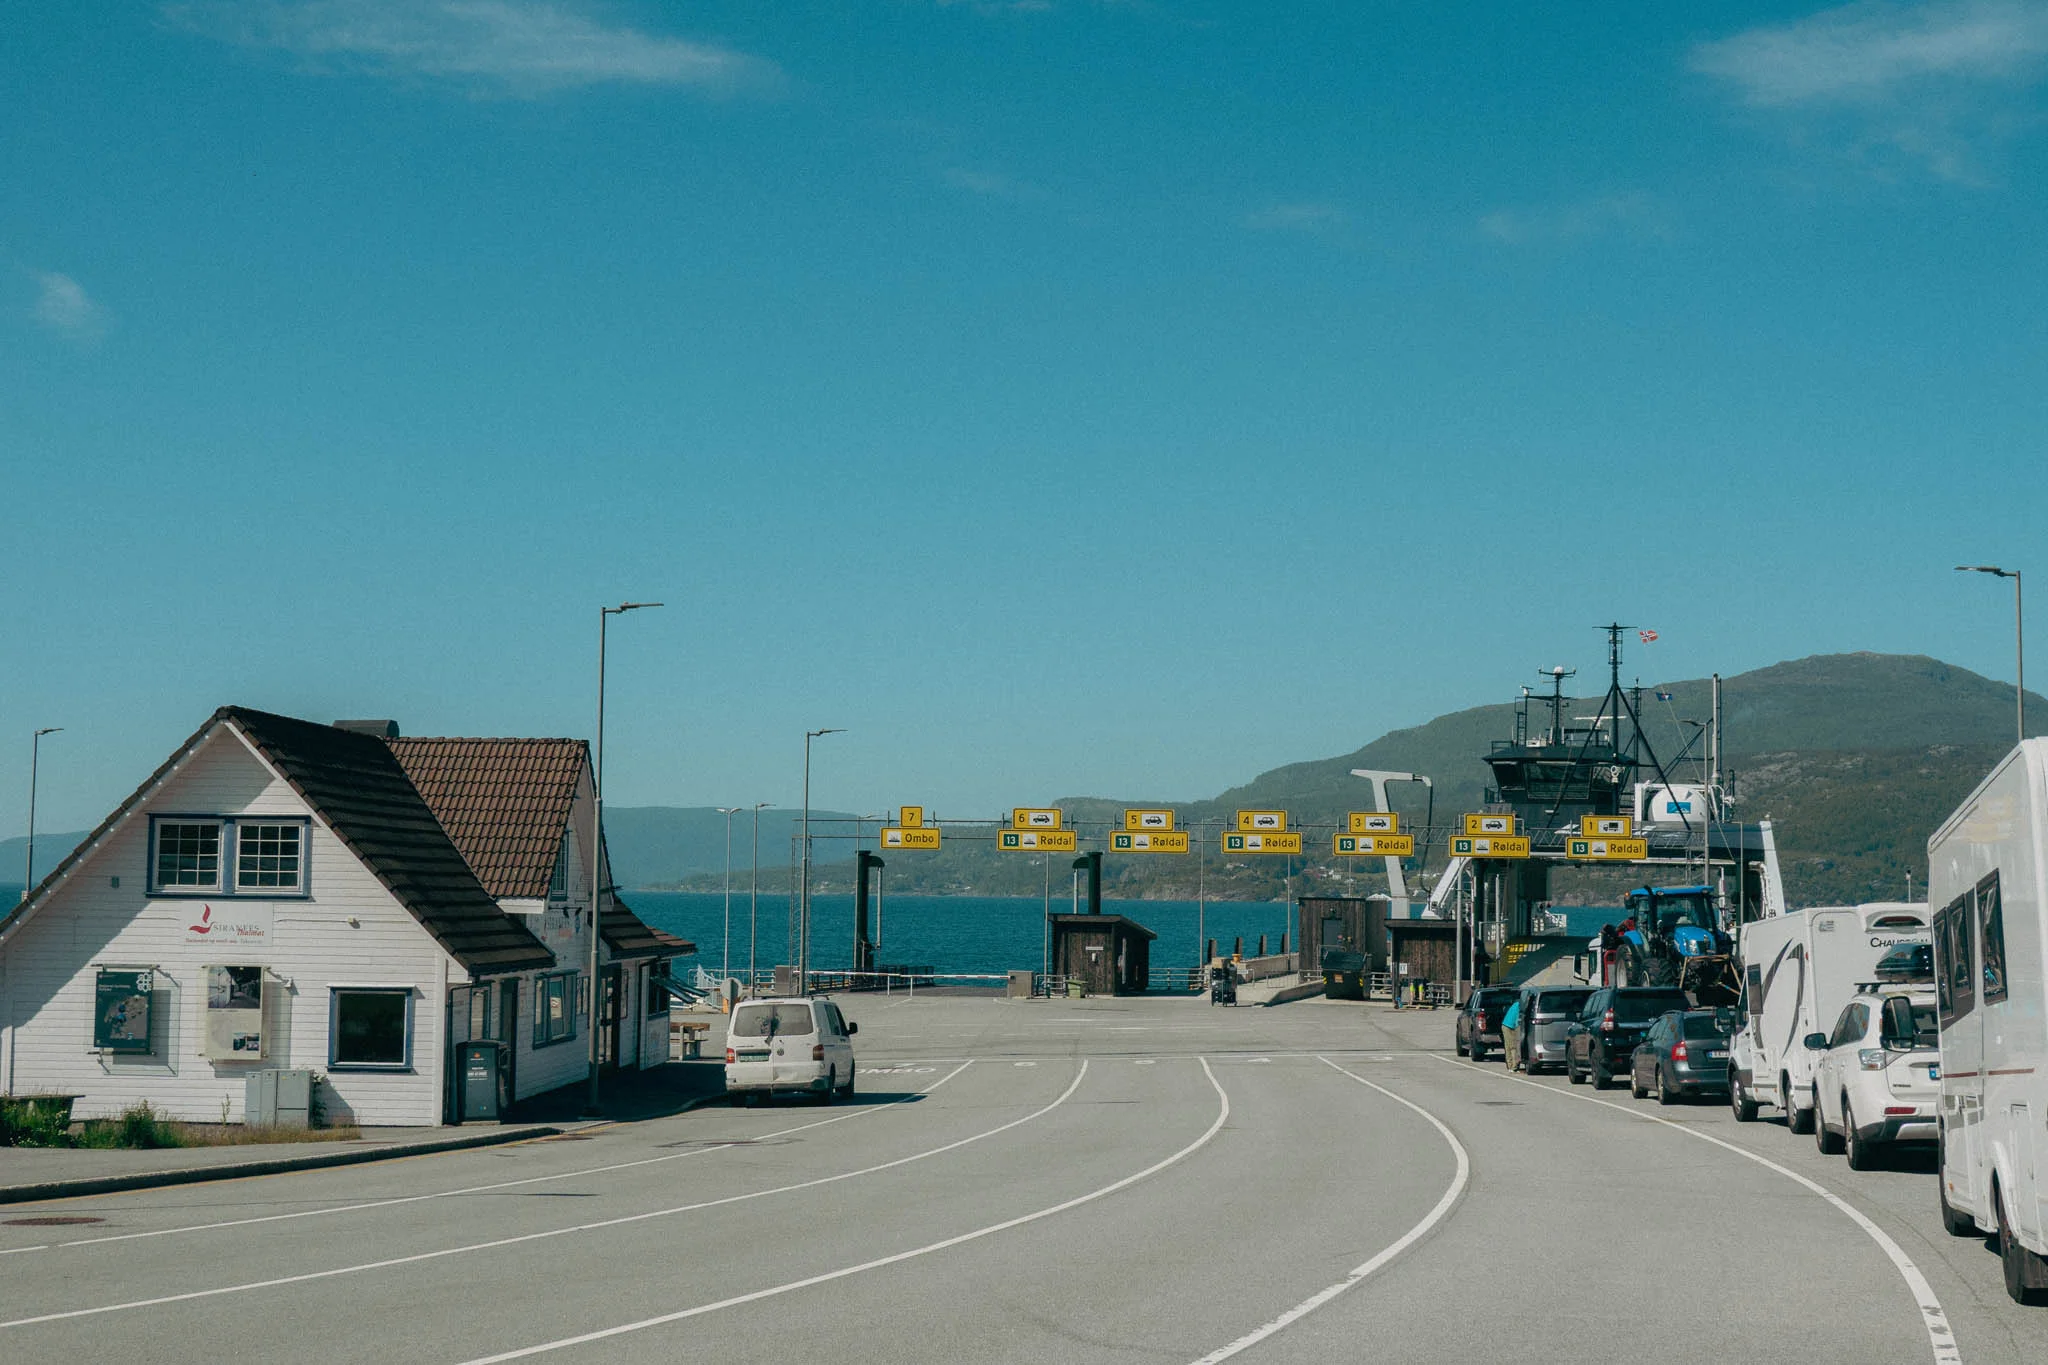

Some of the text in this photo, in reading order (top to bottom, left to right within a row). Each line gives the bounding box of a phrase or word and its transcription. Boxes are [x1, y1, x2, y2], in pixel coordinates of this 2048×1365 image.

[908, 813, 914, 821] 7
[1018, 814, 1025, 823] 6
[1131, 815, 1137, 824] 5
[1243, 816, 1250, 824] 4
[1354, 818, 1361, 827] 3
[1471, 820, 1478, 828] 2
[905, 832, 934, 843] Ombo
[1006, 835, 1072, 846] 13 Røldal
[1118, 837, 1184, 847] 13 Røldal
[1231, 838, 1297, 848] 13 Røldal
[1342, 840, 1409, 850] 13 Røldal
[1459, 841, 1525, 851] 13 Røldal
[1575, 843, 1642, 853] 13 Røldal
